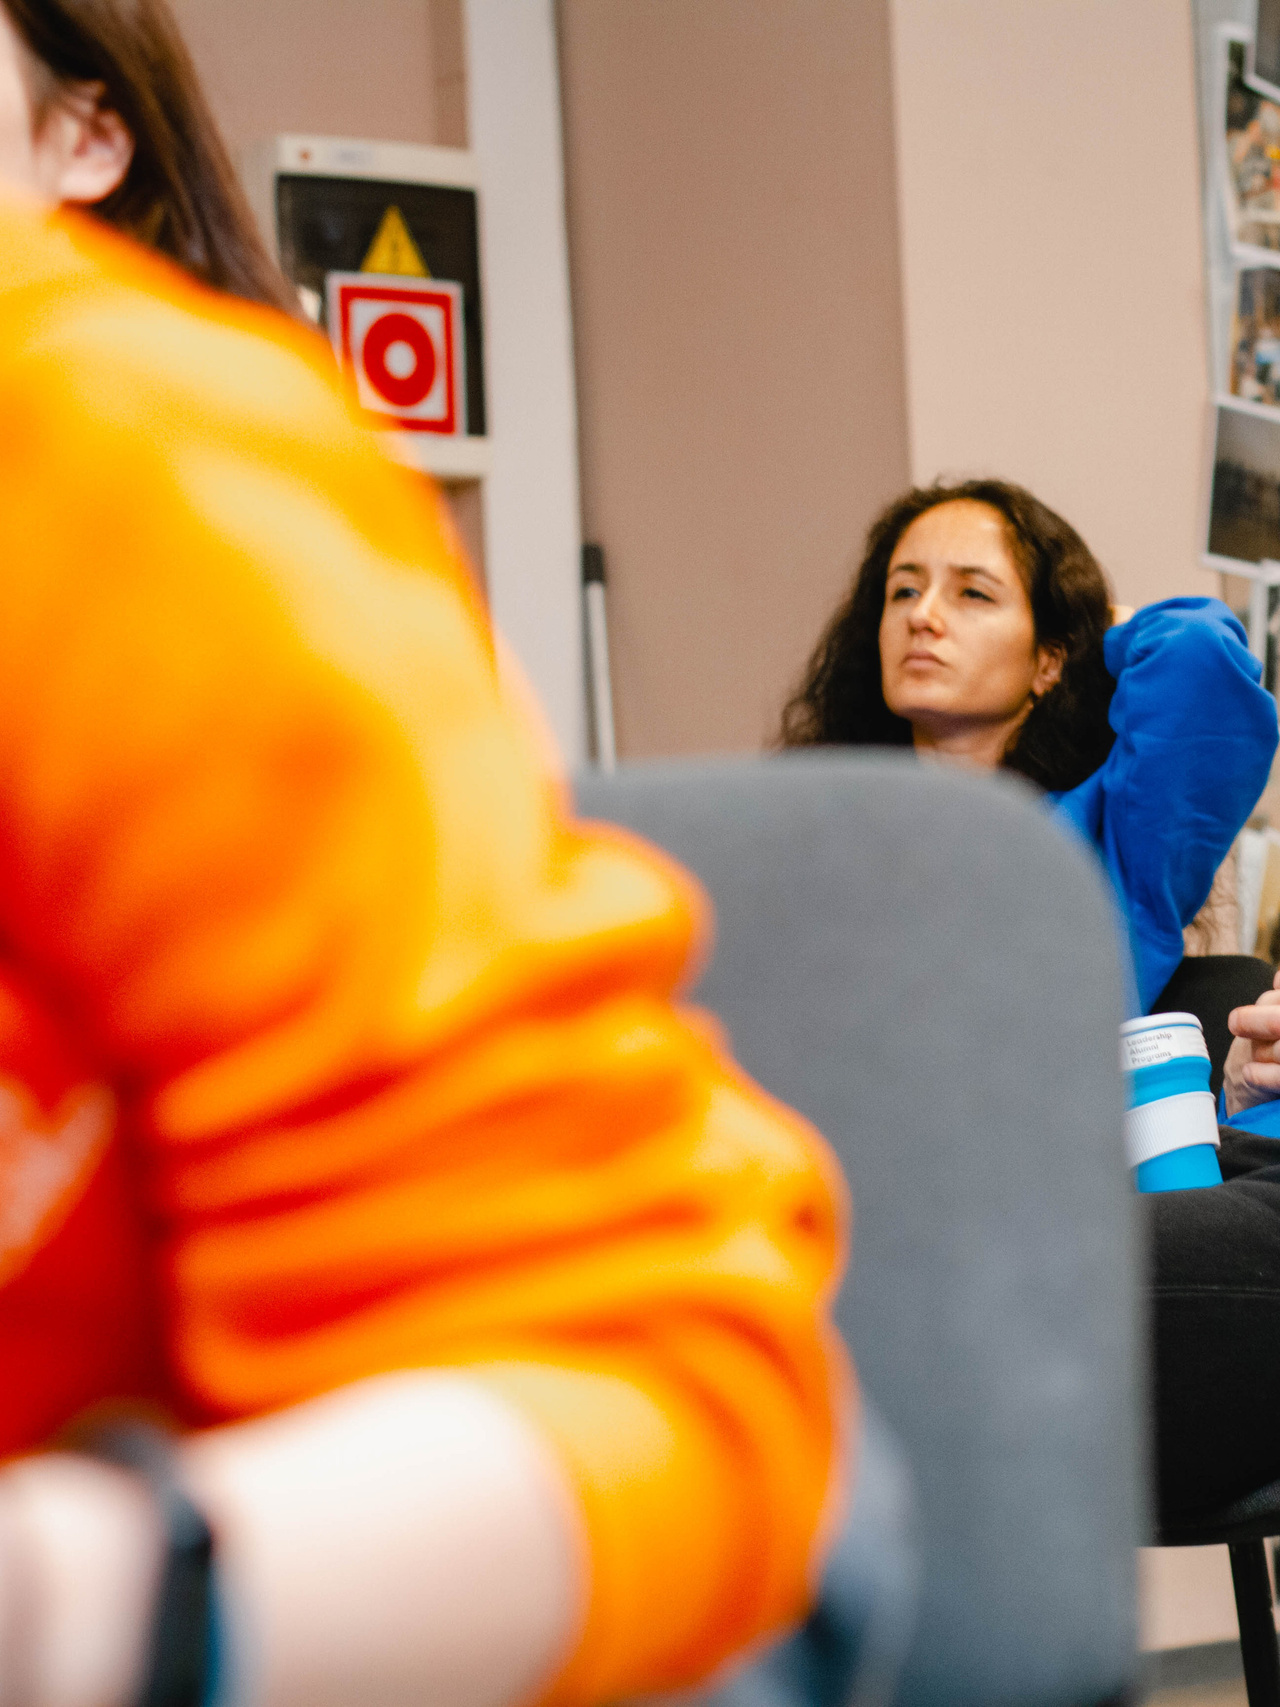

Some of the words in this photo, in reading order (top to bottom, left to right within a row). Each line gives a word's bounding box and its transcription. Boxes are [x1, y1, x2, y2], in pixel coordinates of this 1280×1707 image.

[1126, 1031, 1172, 1046] Leadership
[1130, 1043, 1159, 1055] Alumni
[1131, 1051, 1172, 1064] Programs
